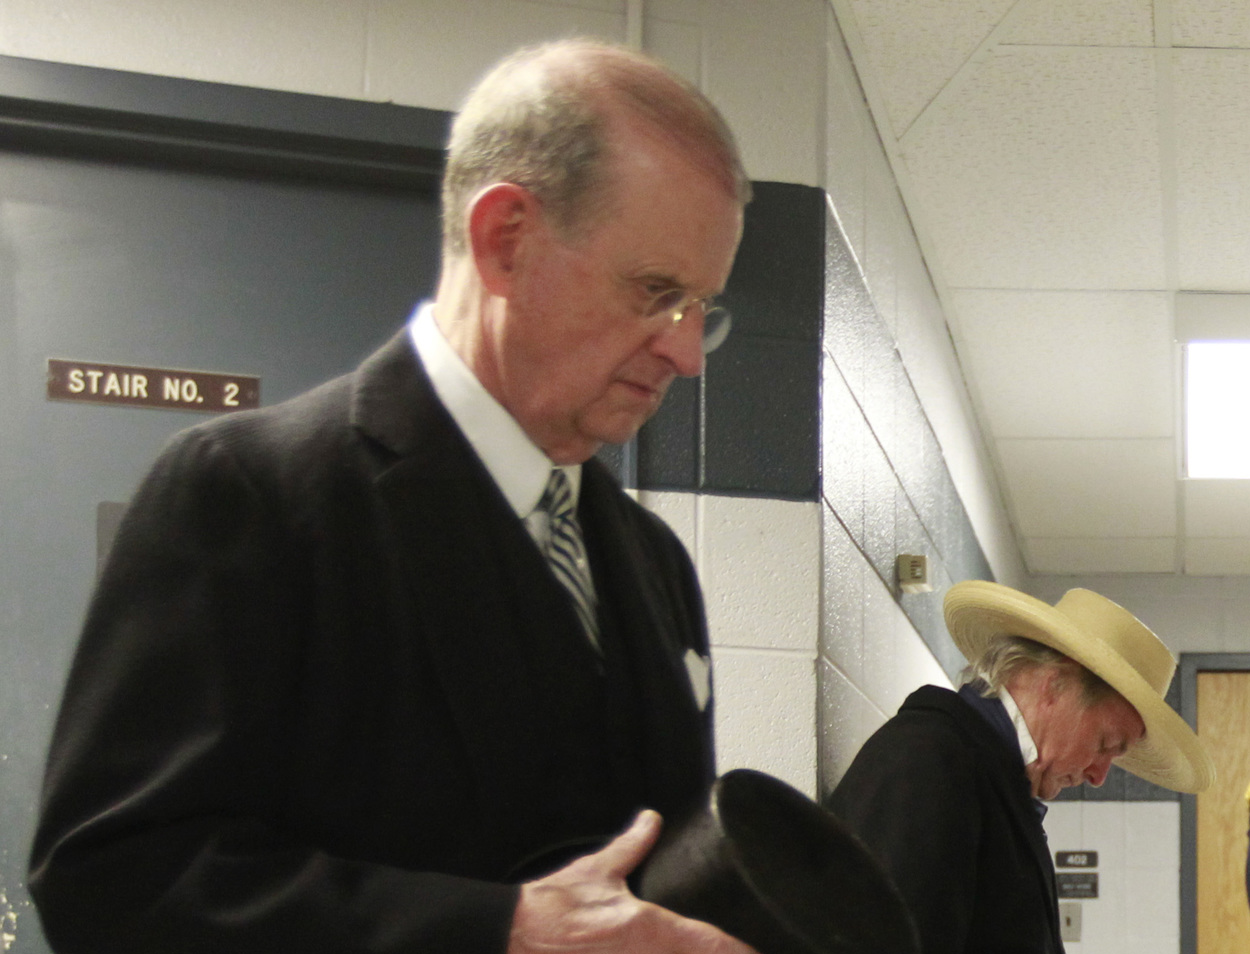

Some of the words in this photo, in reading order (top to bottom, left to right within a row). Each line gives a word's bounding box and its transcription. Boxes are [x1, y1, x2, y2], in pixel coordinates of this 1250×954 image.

[68, 369, 148, 398] STAIR
[163, 377, 204, 404] NO.
[223, 382, 240, 406] 2
